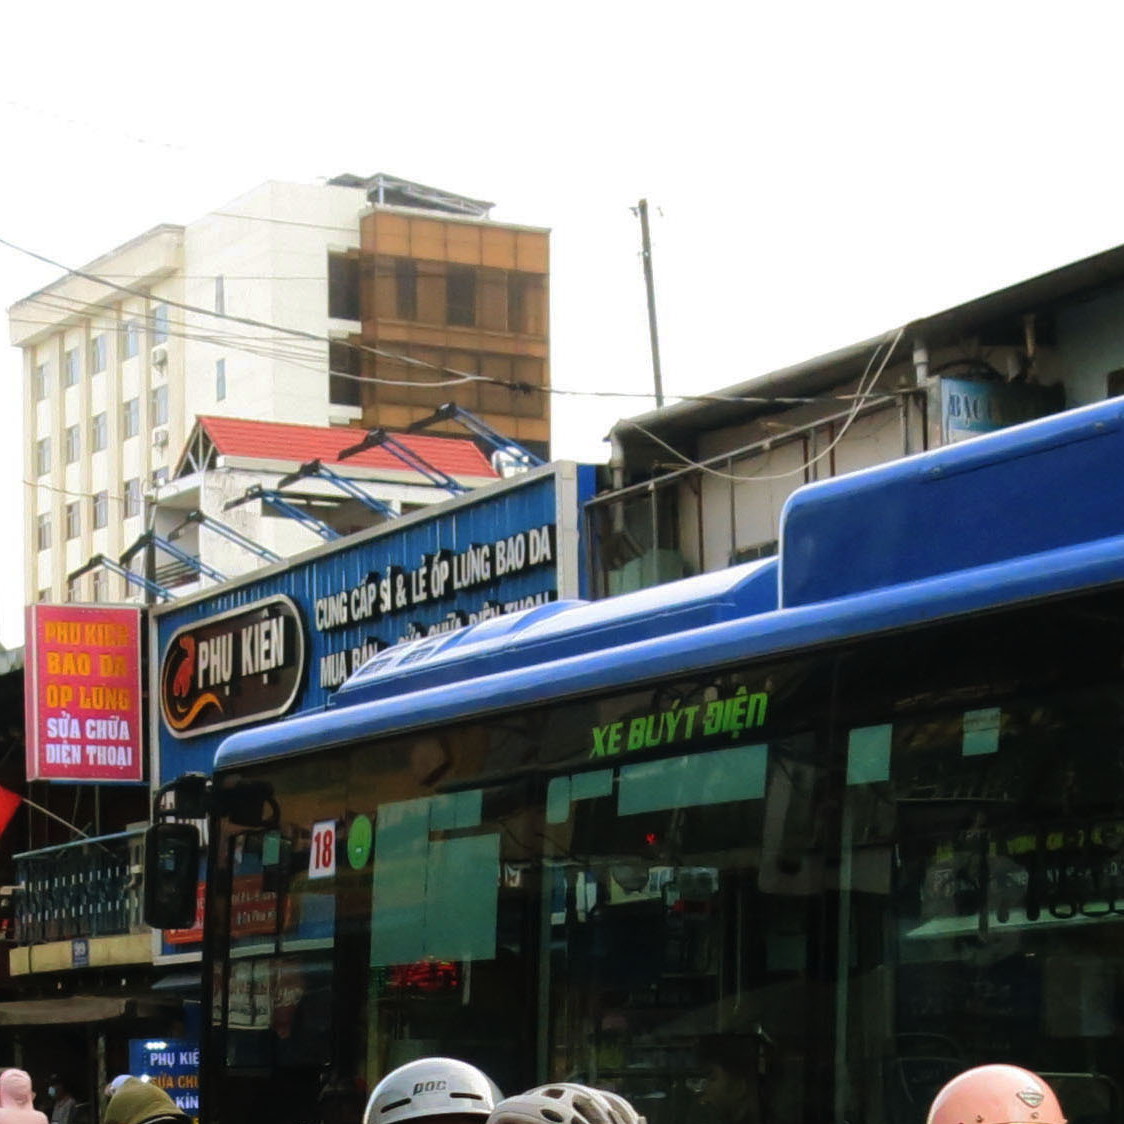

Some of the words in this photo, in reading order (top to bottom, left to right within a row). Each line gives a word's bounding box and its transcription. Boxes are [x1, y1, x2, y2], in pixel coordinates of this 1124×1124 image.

[316, 591, 348, 632] CUNG
[351, 573, 377, 621] CẤP
[396, 573, 408, 609] &
[412, 554, 428, 604] LẺ
[430, 550, 450, 599] ỐP
[496, 533, 526, 577] BAO
[529, 524, 552, 565] DA
[46, 651, 91, 677] BAO
[198, 632, 233, 696] PHỤ
[241, 607, 284, 685] KIỆN
[320, 650, 348, 689] MUA
[47, 710, 81, 739] SỬA
[85, 715, 131, 740] CHỮA
[589, 721, 625, 760] XE
[628, 699, 700, 751] BUÝT
[703, 685, 769, 739] ĐIỆN
[86, 743, 133, 770] THOẠI
[314, 830, 332, 869] 18
[150, 1052, 175, 1068] PHỤ
[179, 1047, 200, 1068] KIỆ
[175, 1092, 200, 1110] KÍN
